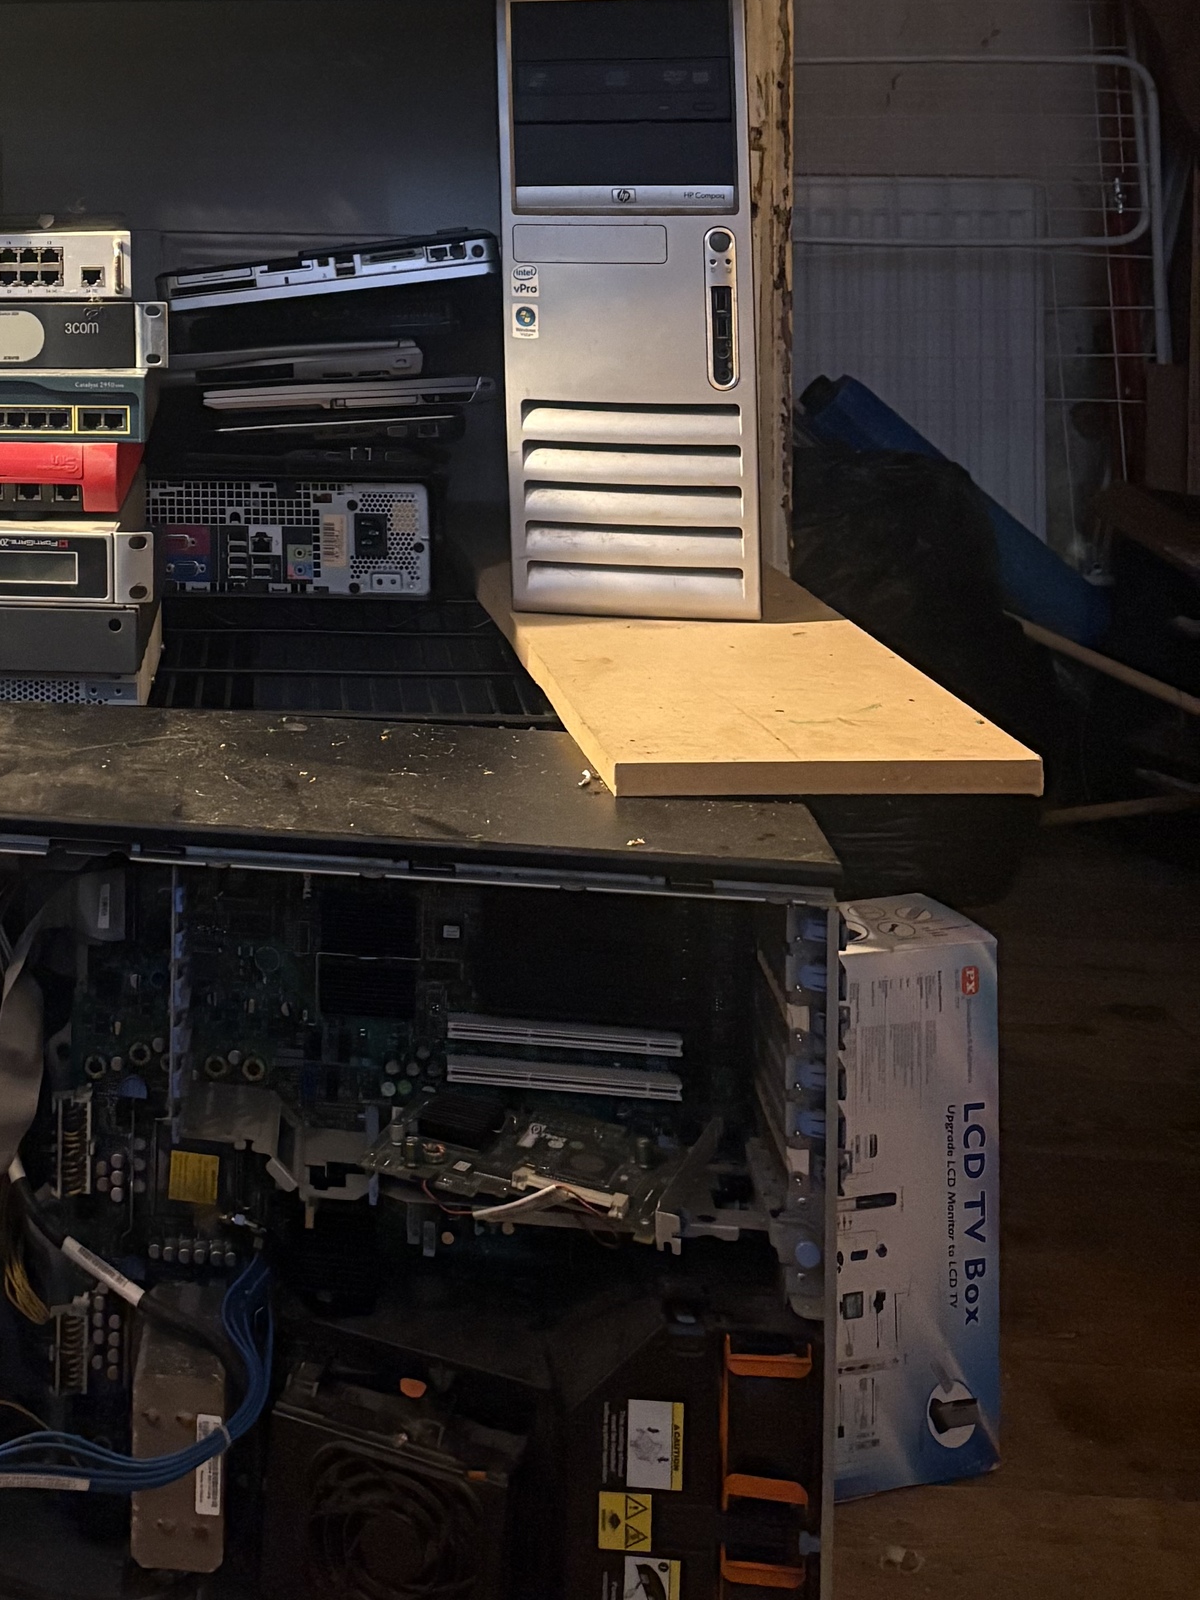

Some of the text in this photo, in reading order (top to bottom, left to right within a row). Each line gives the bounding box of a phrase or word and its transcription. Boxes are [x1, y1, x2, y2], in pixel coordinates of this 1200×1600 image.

[618, 189, 629, 203] hp
[683, 191, 726, 201] HP Compaq
[515, 267, 535, 277] intel
[513, 283, 538, 294] vPro
[74, 381, 99, 389] Catalyst
[965, 969, 976, 993] PX
[945, 1104, 959, 1309] Upgrade LCD Monitor to LCD TV
[963, 1102, 987, 1325] LCD TV Box
[673, 1429, 681, 1472] CAUTION
